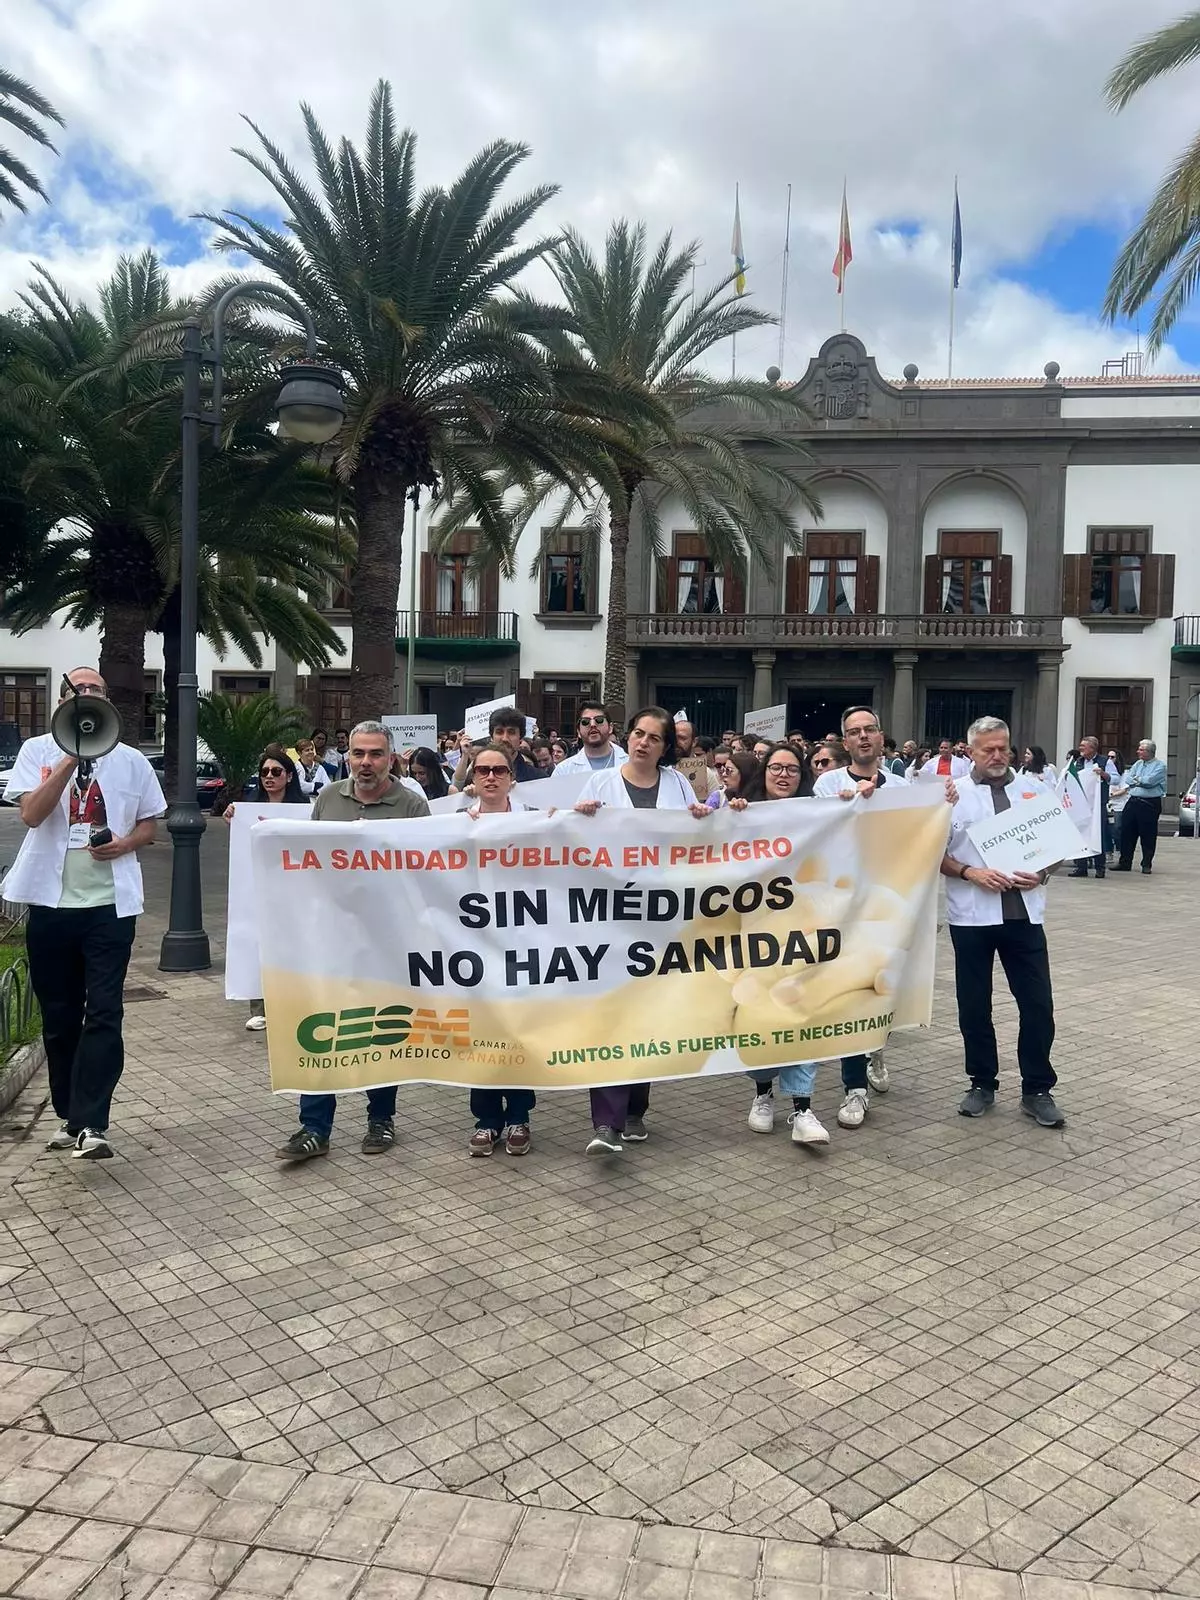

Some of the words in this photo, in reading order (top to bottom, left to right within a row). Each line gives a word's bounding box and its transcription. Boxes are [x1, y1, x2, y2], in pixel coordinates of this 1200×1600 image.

[282, 849, 322, 871] LA
[331, 849, 468, 871] SANIDAD
[479, 843, 613, 868] PÚBLICA
[623, 845, 660, 868] EN
[670, 837, 793, 866] PELIGRO
[981, 823, 1027, 853] ¡ESTATUTO
[1027, 807, 1062, 829] PROPIO
[1016, 831, 1038, 846] YA!
[459, 888, 548, 929] SIN
[568, 875, 795, 924] MÉDICOS
[407, 950, 485, 987] NO
[505, 943, 610, 987] HAY
[626, 927, 842, 977] SANIDAD
[296, 1004, 471, 1055] CESM
[547, 1045, 625, 1066] JUNTOS
[630, 1038, 672, 1059] MÁS
[677, 1032, 767, 1054] FUERTES.
[771, 1030, 795, 1045] TE
[799, 1010, 897, 1042] NECESITAMO
[298, 1050, 382, 1070] SINDICATO
[389, 1045, 451, 1061] MÉDICO
[457, 1050, 526, 1066] CANARIO
